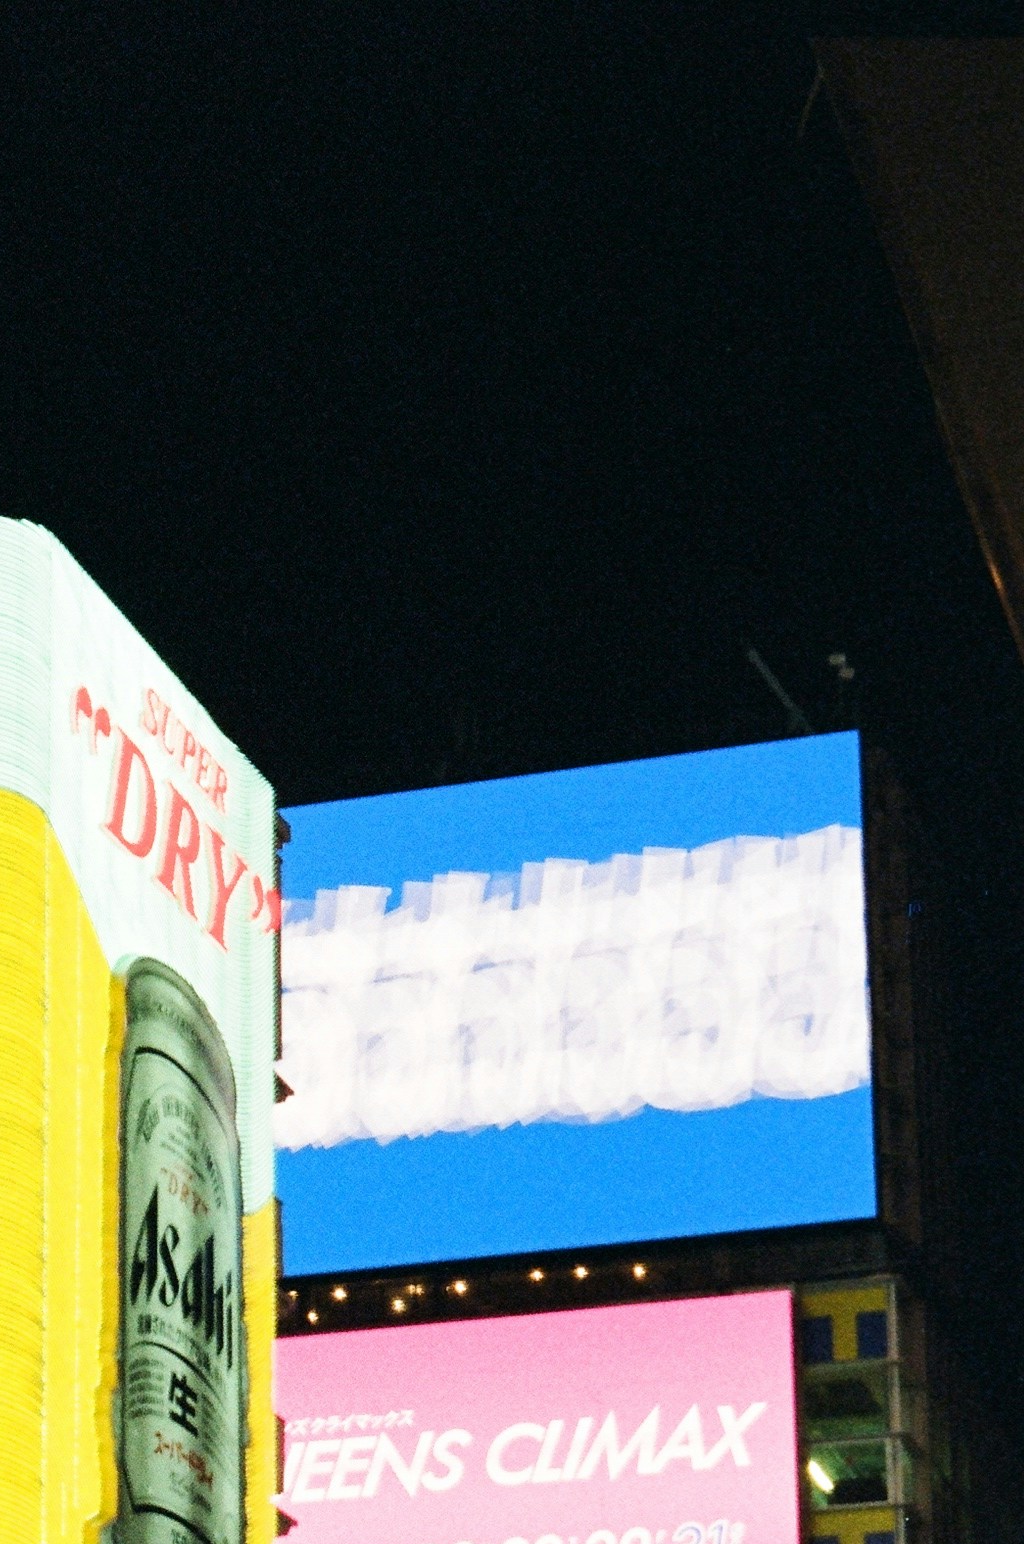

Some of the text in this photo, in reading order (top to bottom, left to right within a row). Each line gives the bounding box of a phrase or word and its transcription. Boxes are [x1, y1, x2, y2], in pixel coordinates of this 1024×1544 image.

[141, 687, 228, 813] SUPER
[130, 1181, 233, 1372] Asahi
[168, 1370, 199, 1438] 生
[485, 1401, 769, 1487] CLIMAX
